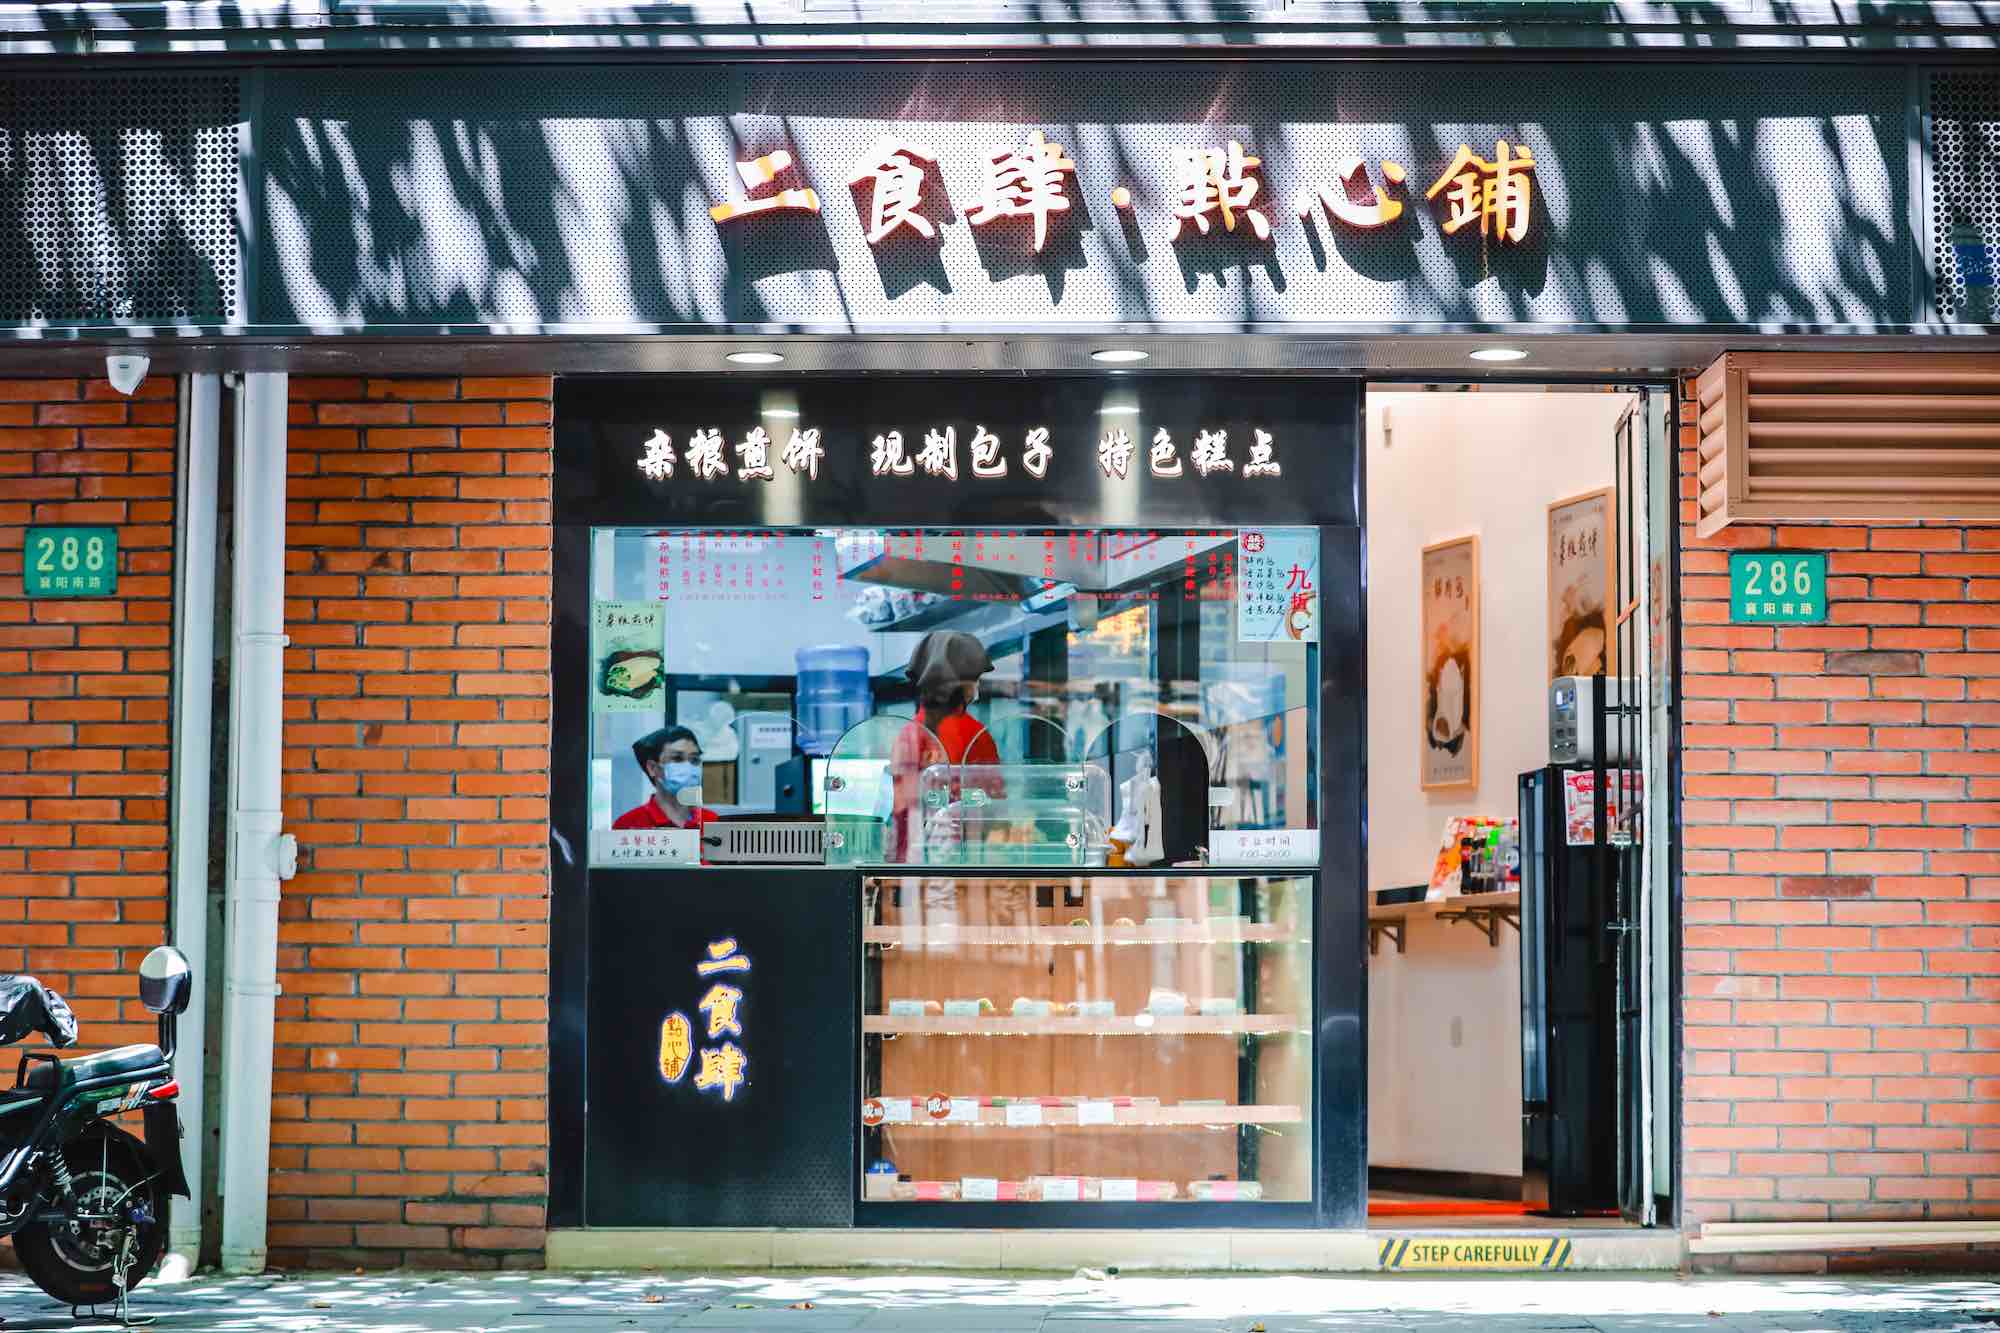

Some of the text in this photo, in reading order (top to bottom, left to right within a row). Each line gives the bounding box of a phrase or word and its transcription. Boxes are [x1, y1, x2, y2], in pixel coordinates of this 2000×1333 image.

[637, 426, 1282, 481] 杂粮煎饼 现制包子 特色糕点
[36, 536, 104, 571] 288
[1745, 561, 1811, 595] 286
[1412, 1245, 1539, 1262] STEP CAREFULLY
